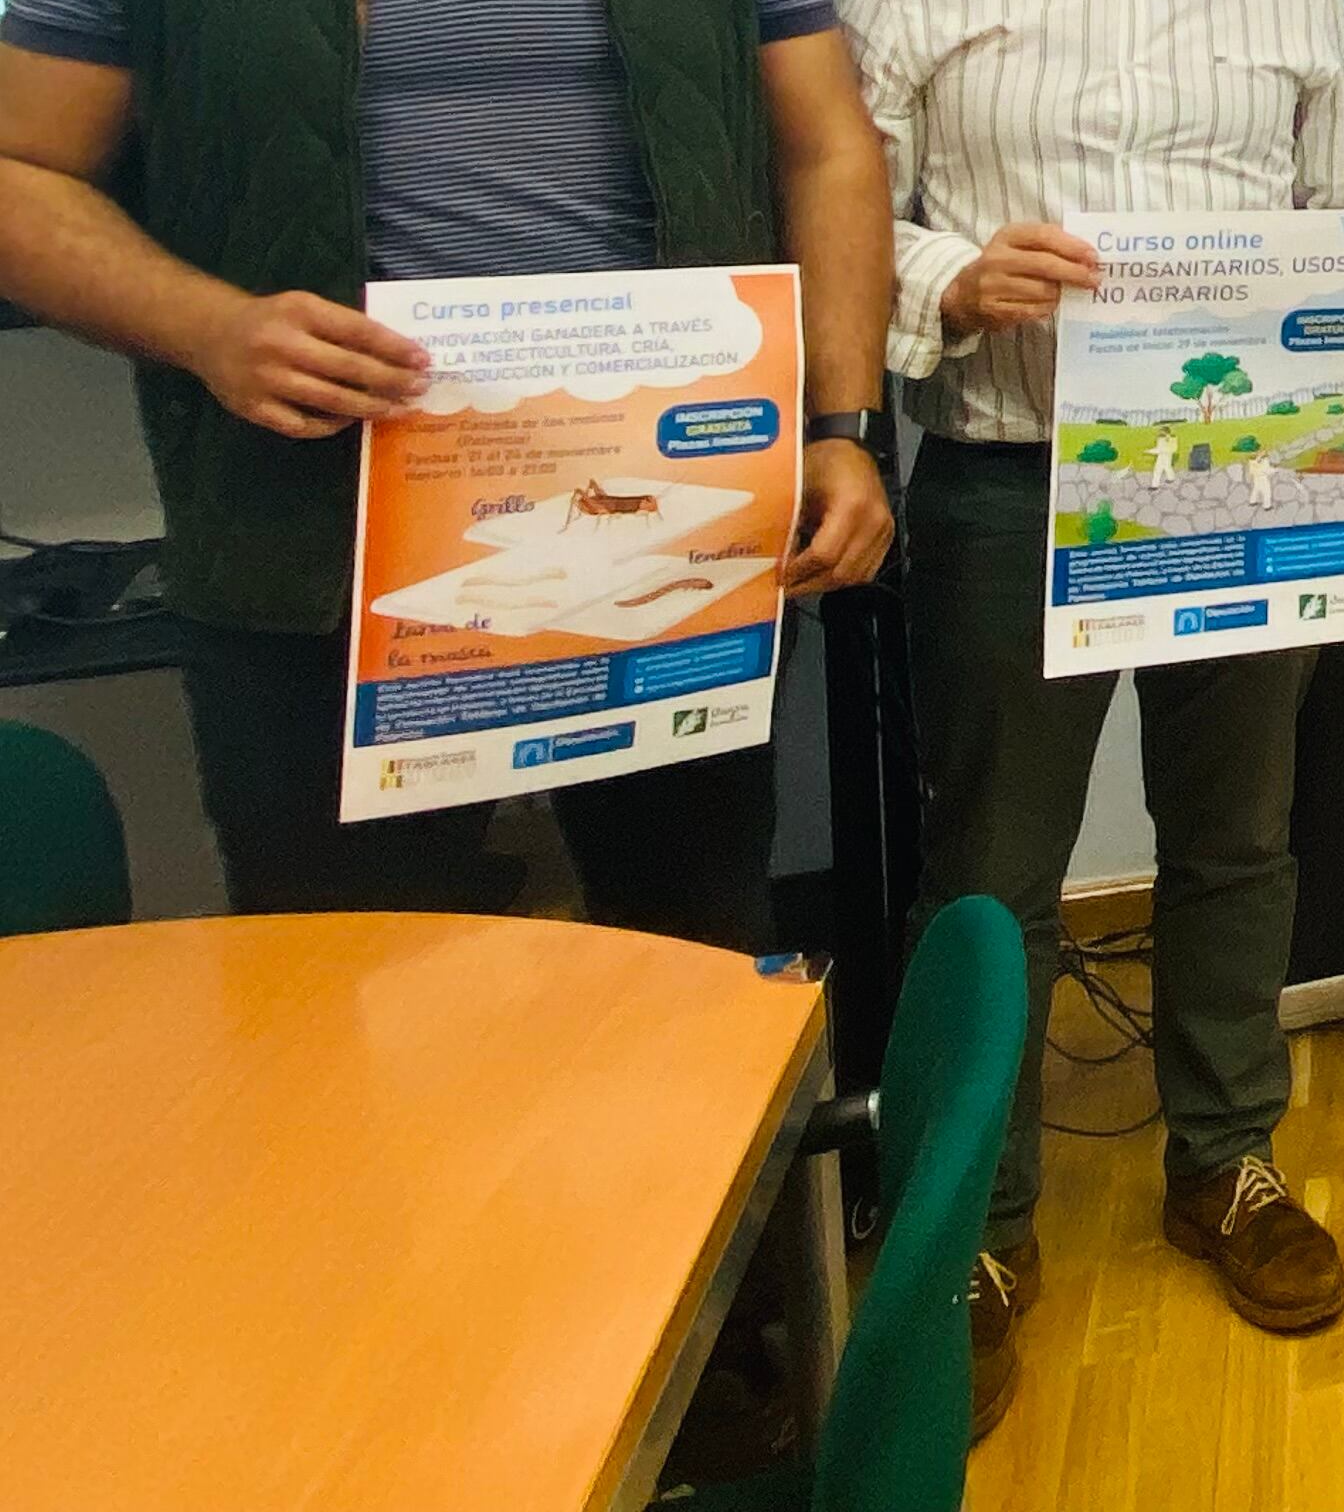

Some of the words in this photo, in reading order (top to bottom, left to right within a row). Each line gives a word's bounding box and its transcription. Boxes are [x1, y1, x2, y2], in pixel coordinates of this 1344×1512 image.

[1097, 231, 1176, 253] Curso
[1185, 229, 1264, 250] online
[412, 300, 490, 321] Curso
[500, 291, 633, 322] presencial
[1092, 286, 1125, 305] NO
[1133, 284, 1250, 304] AGRARIOS
